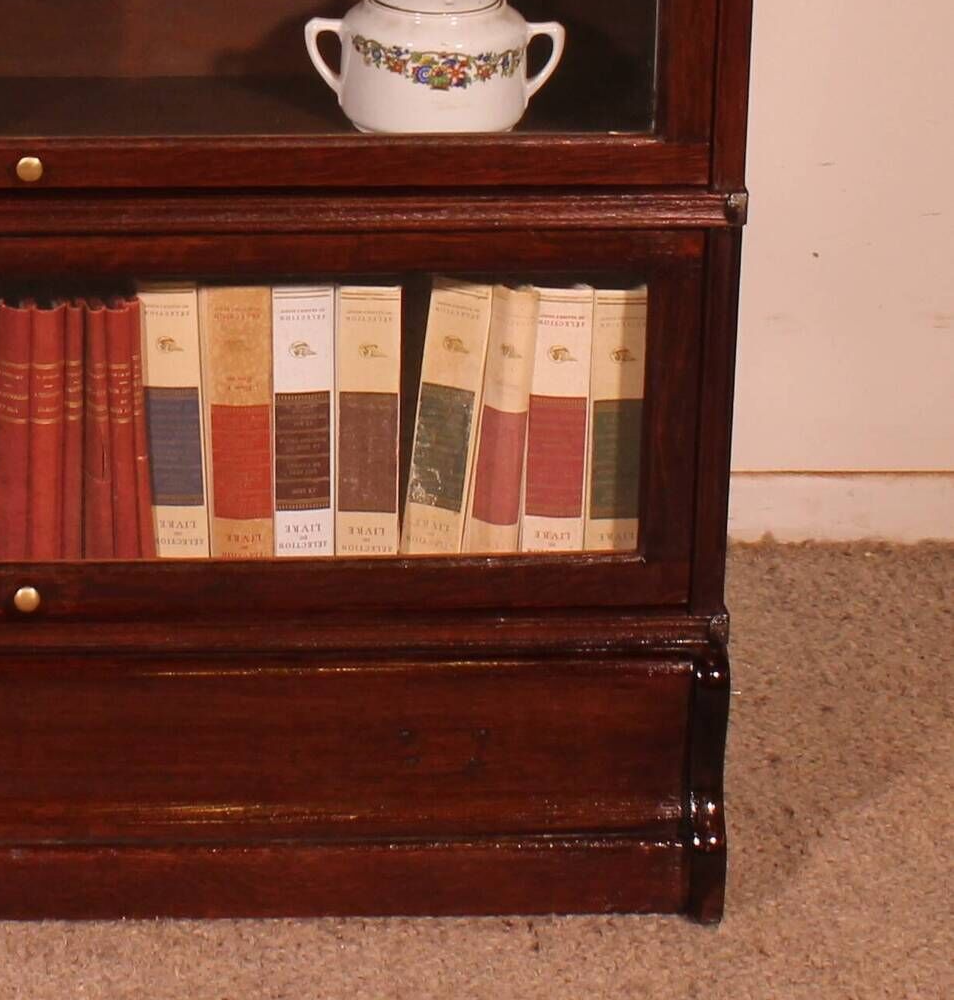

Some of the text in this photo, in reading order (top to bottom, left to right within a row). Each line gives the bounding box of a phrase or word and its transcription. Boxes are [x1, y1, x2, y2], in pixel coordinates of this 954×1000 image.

[159, 519, 197, 529] LIVRE
[285, 523, 321, 533] LIVRE
[347, 526, 385, 537] LIVRE
[535, 531, 571, 541] LIVRE
[156, 536, 204, 547] SÉLECTIO
[226, 533, 263, 544] LIVRE
